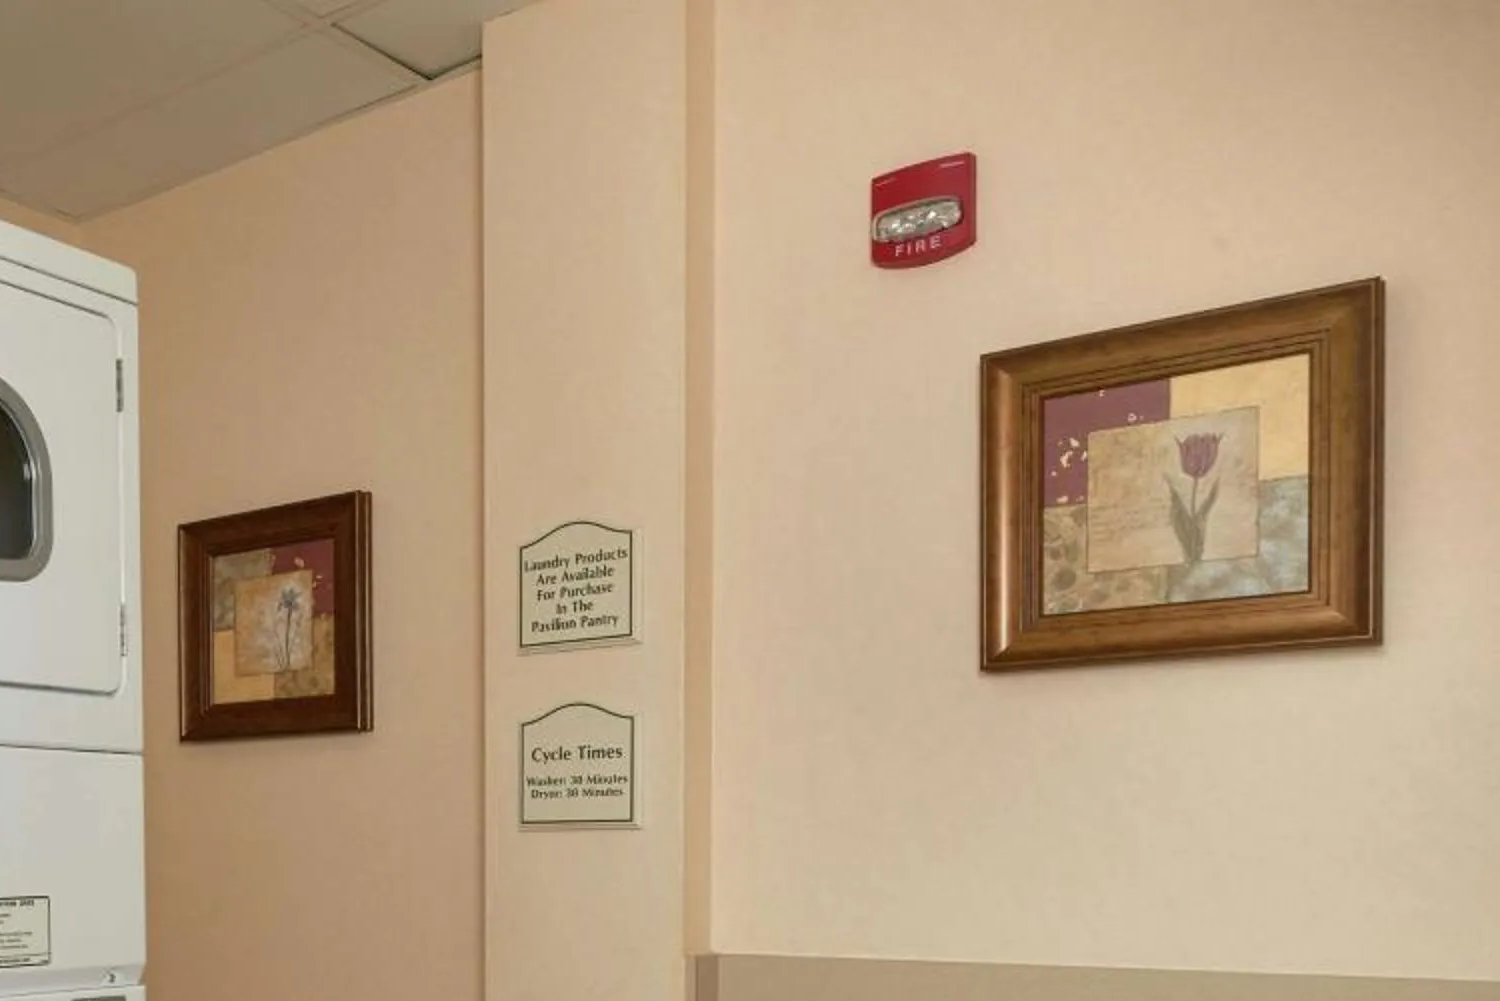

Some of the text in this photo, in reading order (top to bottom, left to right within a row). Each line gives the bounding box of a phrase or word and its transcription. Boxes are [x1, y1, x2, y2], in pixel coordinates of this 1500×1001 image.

[895, 235, 942, 257] FIRE
[524, 548, 628, 573] Laundry Products
[535, 565, 615, 587] Are Available
[536, 582, 614, 602] For Purchase
[555, 600, 593, 615] In The
[531, 613, 619, 633] Pavilion Pantry
[531, 744, 624, 764] Cycle Times
[587, 773, 629, 786] Minutes
[531, 788, 563, 800] Dryer:
[582, 786, 624, 798] Minutes
